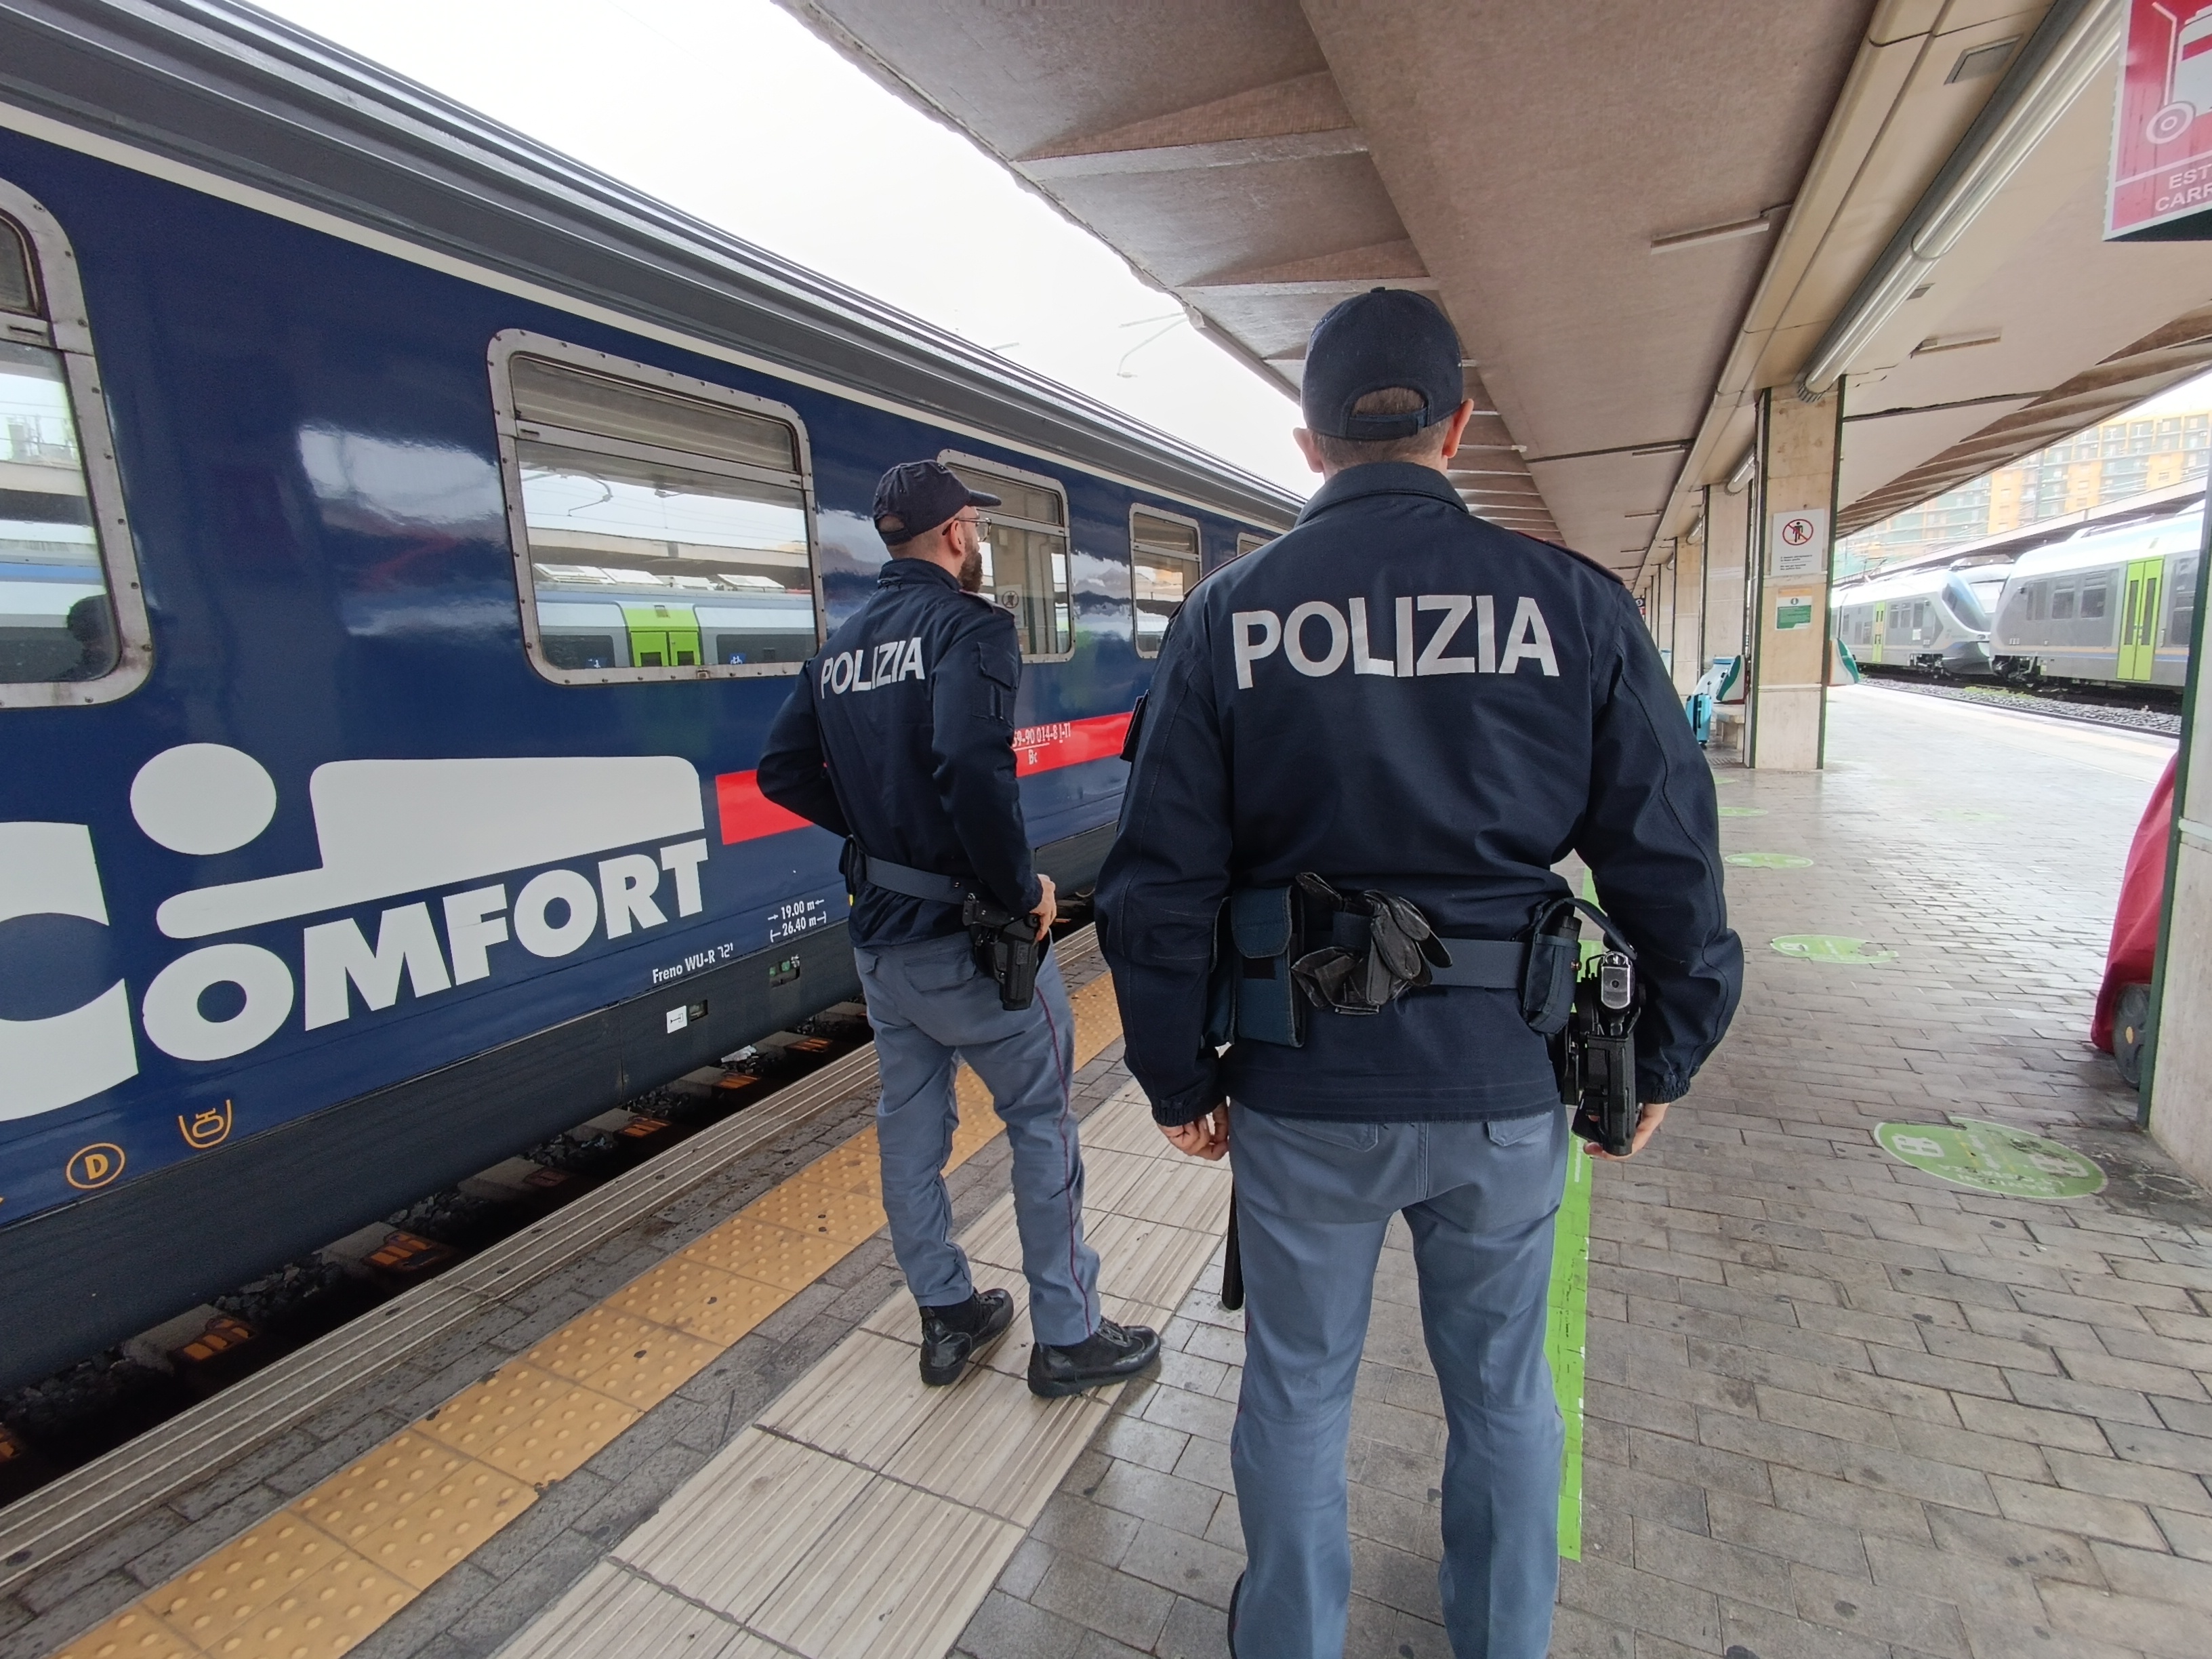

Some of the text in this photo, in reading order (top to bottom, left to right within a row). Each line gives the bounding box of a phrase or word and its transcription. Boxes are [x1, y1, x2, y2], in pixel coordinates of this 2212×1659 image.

[2169, 163, 2212, 190] EST
[1233, 594, 1560, 690] POLIZIA
[821, 637, 926, 699] POLIZIA
[781, 900, 815, 920] 19.00 m
[782, 917, 817, 937] 26.40 m
[651, 964, 683, 984] Freno
[684, 949, 716, 972] WU-R
[84, 1153, 109, 1181] D
